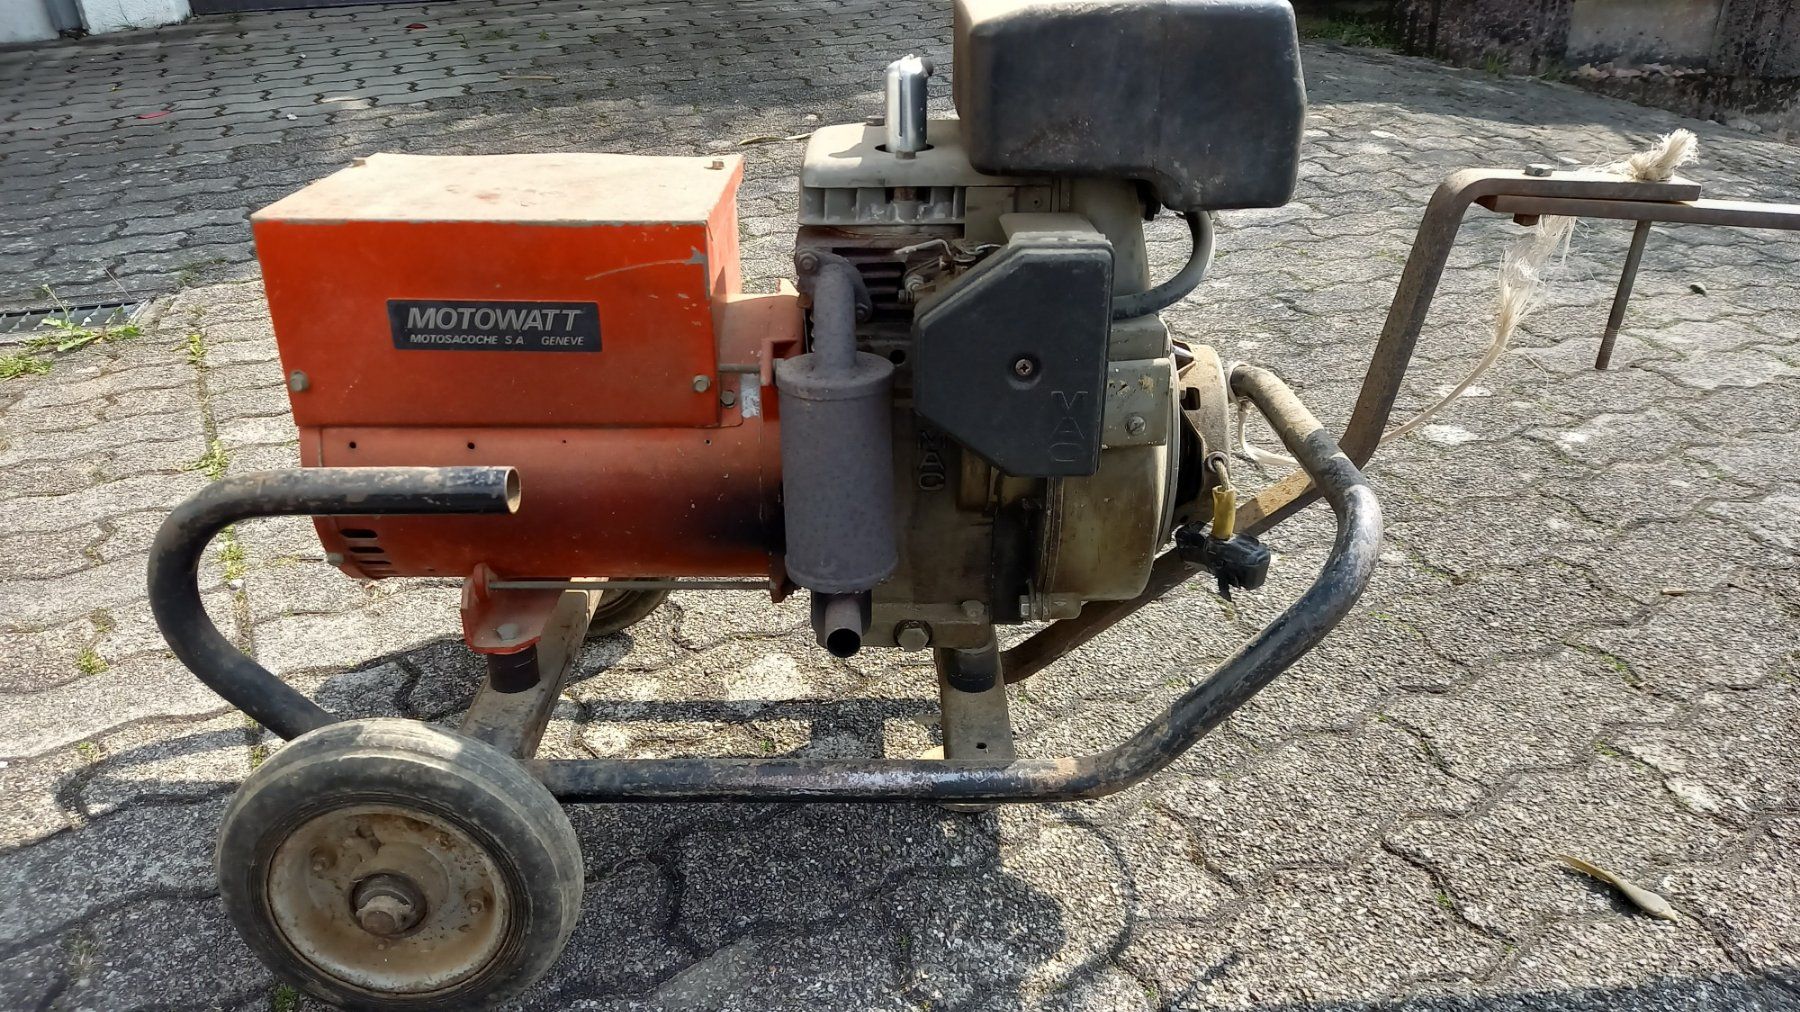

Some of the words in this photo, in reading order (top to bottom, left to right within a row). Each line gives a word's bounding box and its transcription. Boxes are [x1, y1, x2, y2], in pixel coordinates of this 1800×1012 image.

[407, 306, 584, 331] MOTOWATT
[409, 334, 498, 345] MOTOSACOCHE
[541, 336, 585, 346] GENEVE
